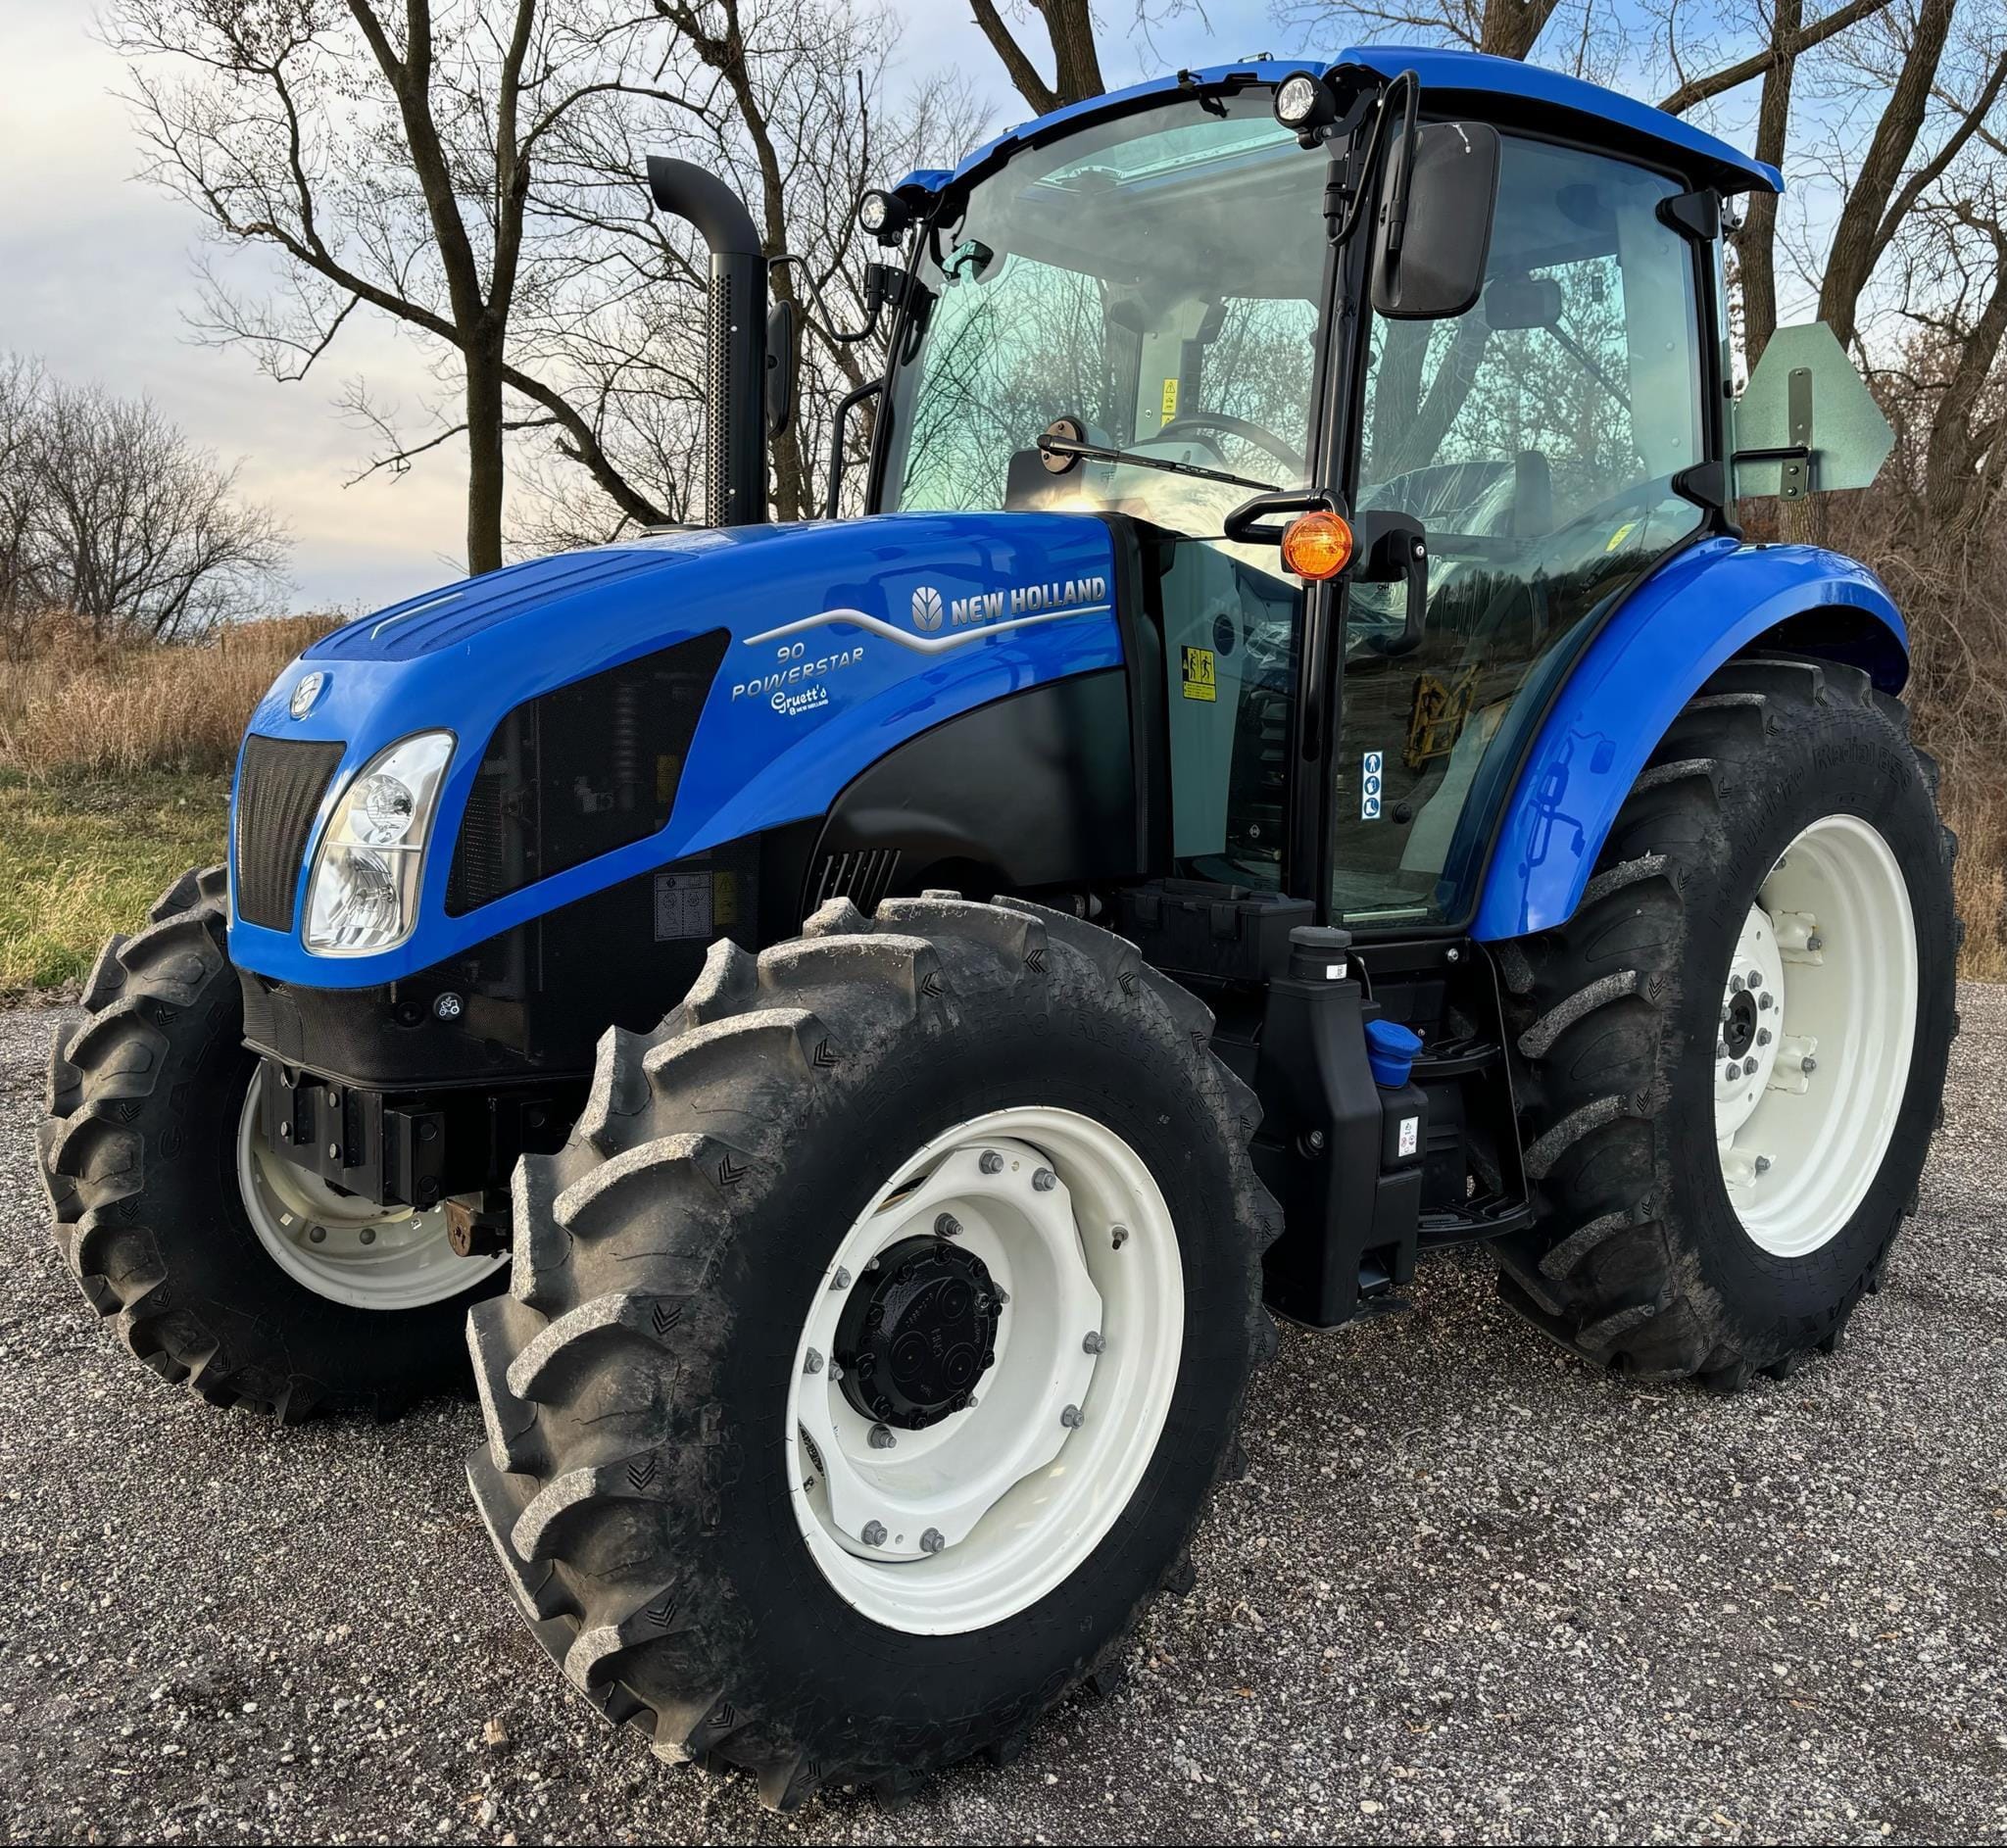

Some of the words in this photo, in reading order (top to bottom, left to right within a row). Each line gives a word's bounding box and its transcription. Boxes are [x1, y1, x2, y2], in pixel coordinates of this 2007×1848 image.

[951, 592, 1004, 626] NEW
[1010, 576, 1106, 614] HOLLAND
[777, 642, 805, 664] 90
[731, 647, 863, 703] POWERSTAR
[770, 684, 827, 713] Gruett's
